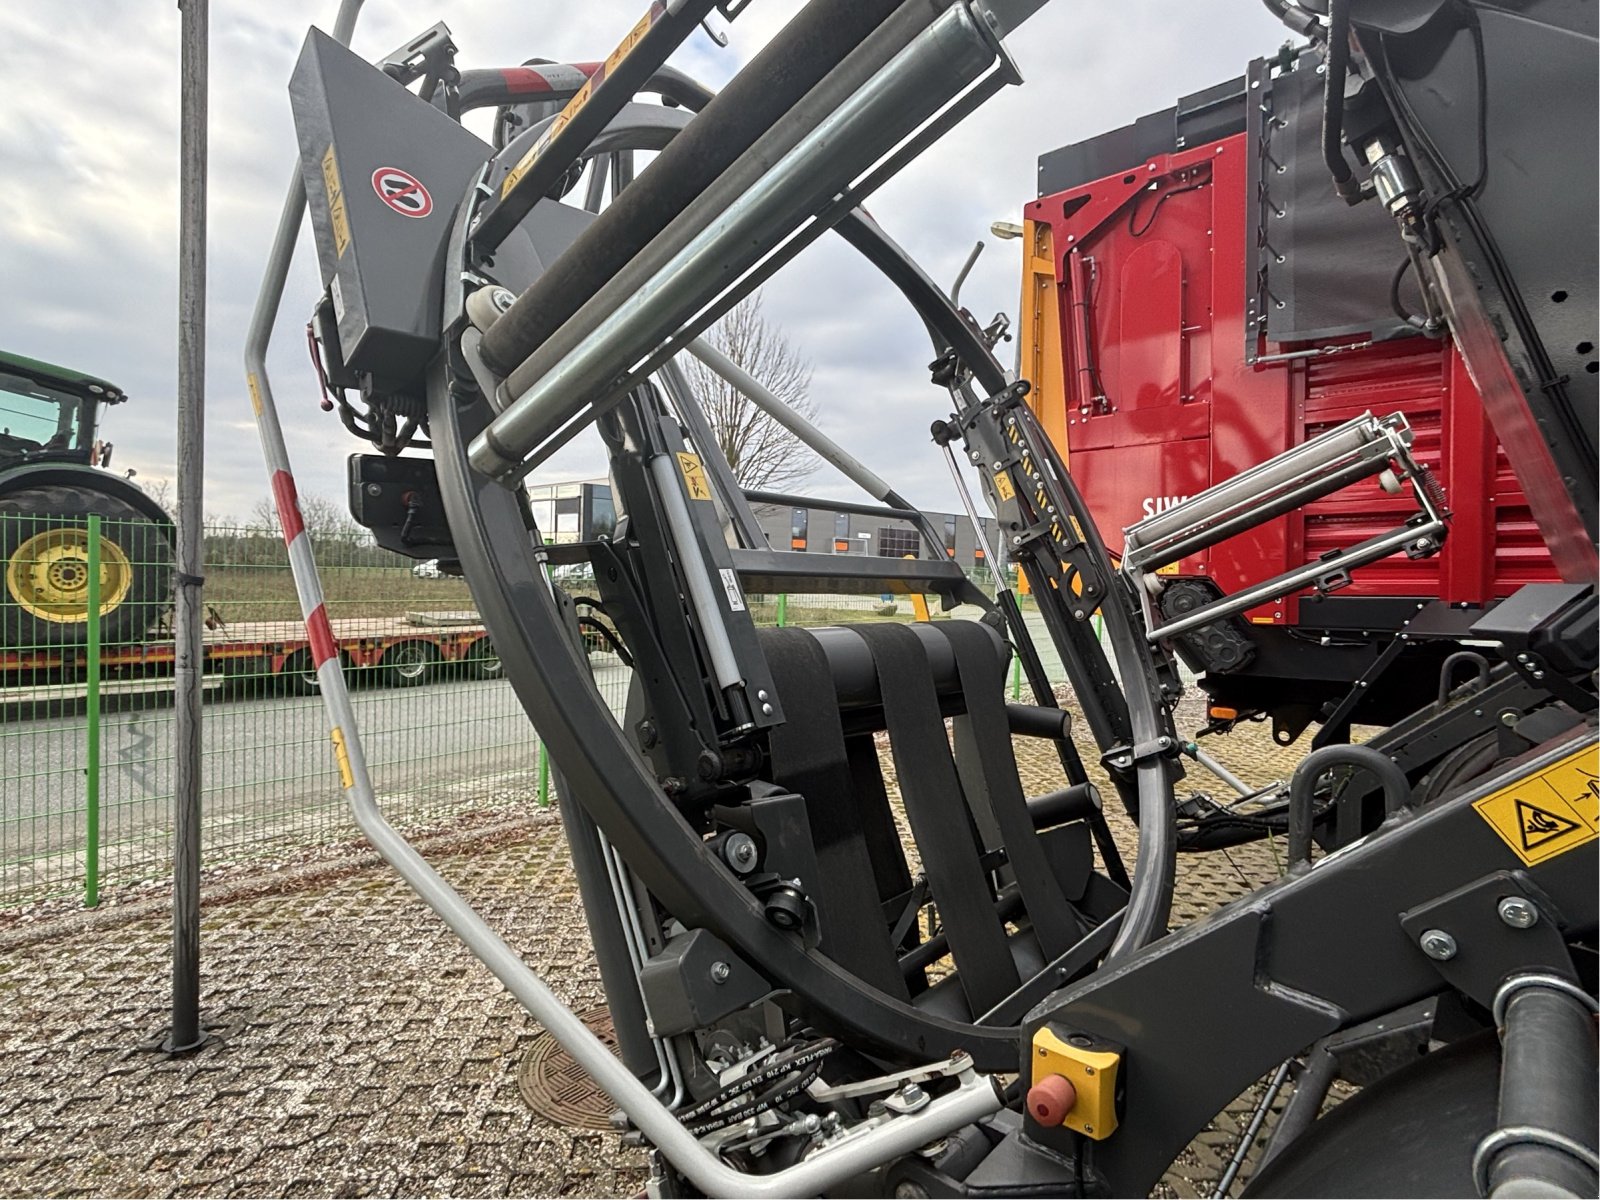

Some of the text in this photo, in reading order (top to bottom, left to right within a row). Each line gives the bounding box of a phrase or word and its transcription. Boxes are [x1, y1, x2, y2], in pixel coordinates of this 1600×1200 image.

[1142, 495, 1190, 520] SIW
[755, 1100, 768, 1111] WP
[726, 1111, 743, 1123] BAR
